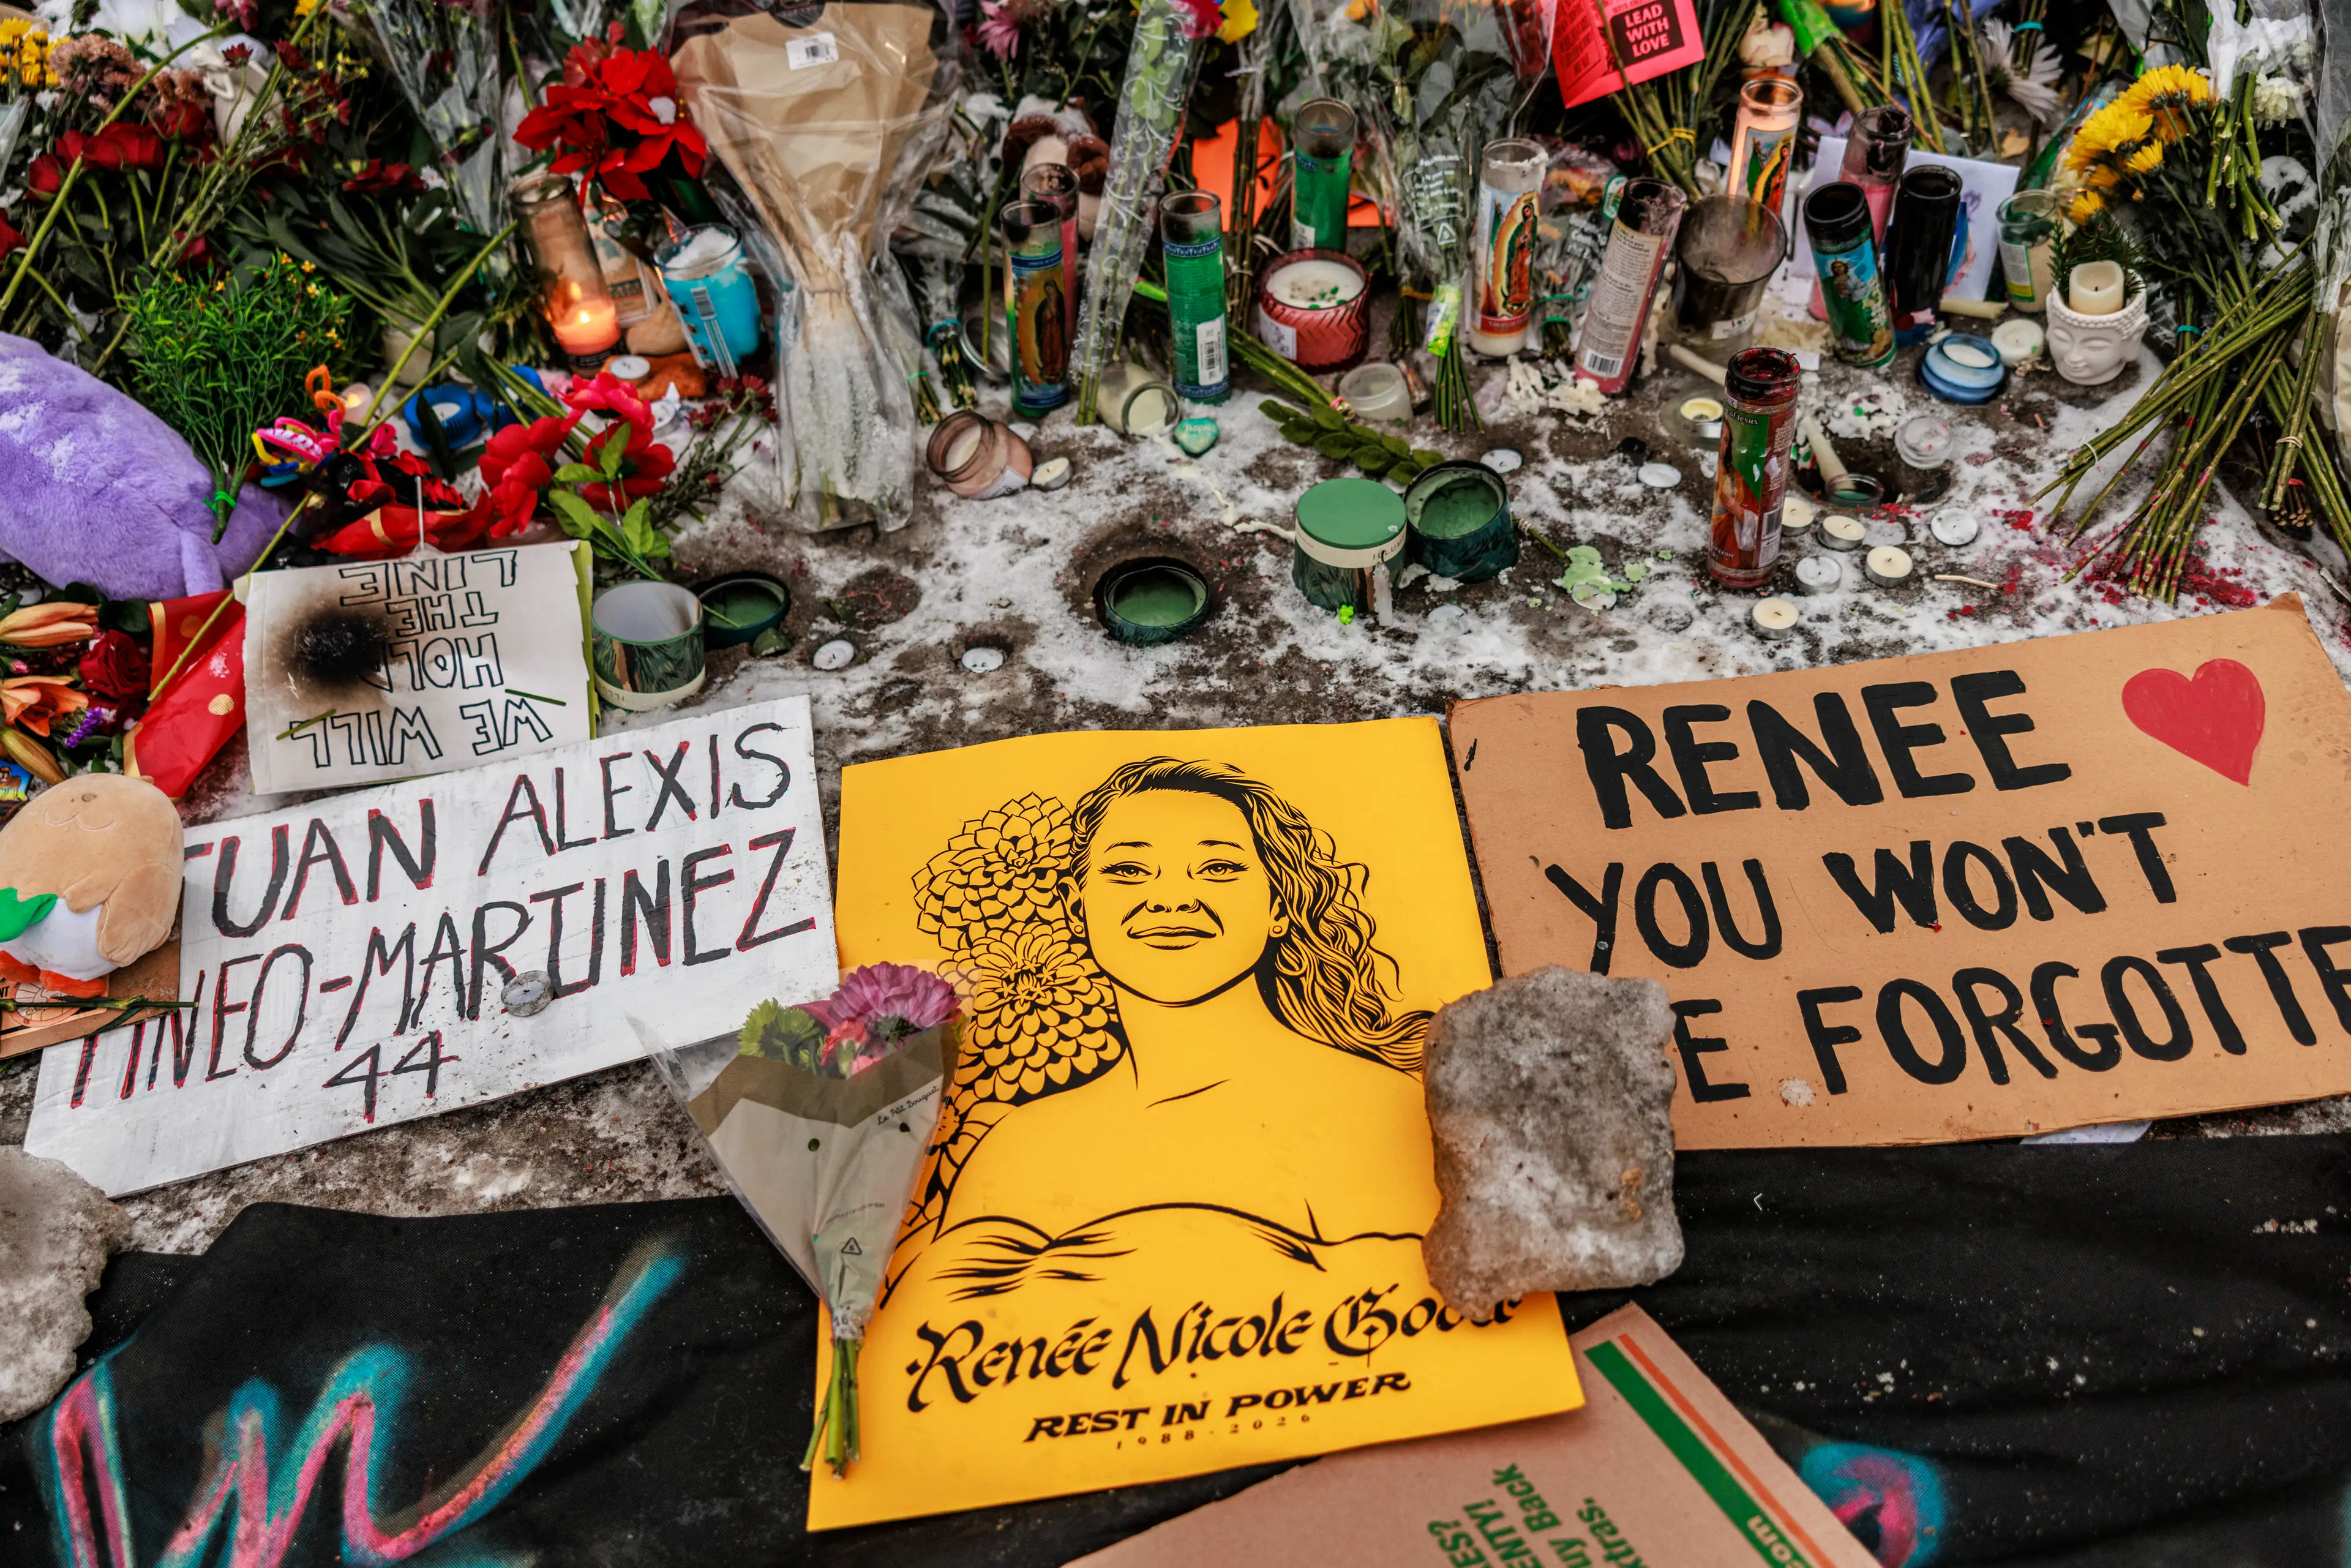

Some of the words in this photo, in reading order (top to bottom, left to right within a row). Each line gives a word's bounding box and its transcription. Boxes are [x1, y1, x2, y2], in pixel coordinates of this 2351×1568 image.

[1624, 3, 1663, 28] LEAD
[1625, 16, 1670, 43] WITH
[1632, 33, 1671, 58] LOVE
[1737, 415, 1759, 425] Jesus
[339, 550, 518, 607] LINE
[385, 590, 500, 638] THE
[290, 706, 443, 768] WILL
[459, 697, 553, 756] WE
[1577, 669, 2072, 830] RENEE
[184, 798, 437, 939] UAN
[478, 721, 797, 877] ALEXIS
[1544, 858, 1783, 977] YOU
[1822, 811, 2178, 935] WON'T
[1671, 998, 1751, 1103] E
[1797, 925, 2351, 1096] FORGOTTE
[321, 1029, 460, 1124] 44
[877, 1115, 890, 1125] Le
[906, 1315, 1113, 1413] Renée
[1111, 1290, 1316, 1390] Nicole
[1022, 1406, 1151, 1442] REST
[1161, 1399, 1213, 1427] IN
[1224, 1371, 1412, 1418] POWER
[1492, 1462, 1562, 1532] Back
[1427, 1519, 1493, 1568] ES?
[1462, 1498, 1544, 1568] ENTY!
[1547, 1537, 1592, 1568] uy
[1577, 1496, 1648, 1568] xtras.
